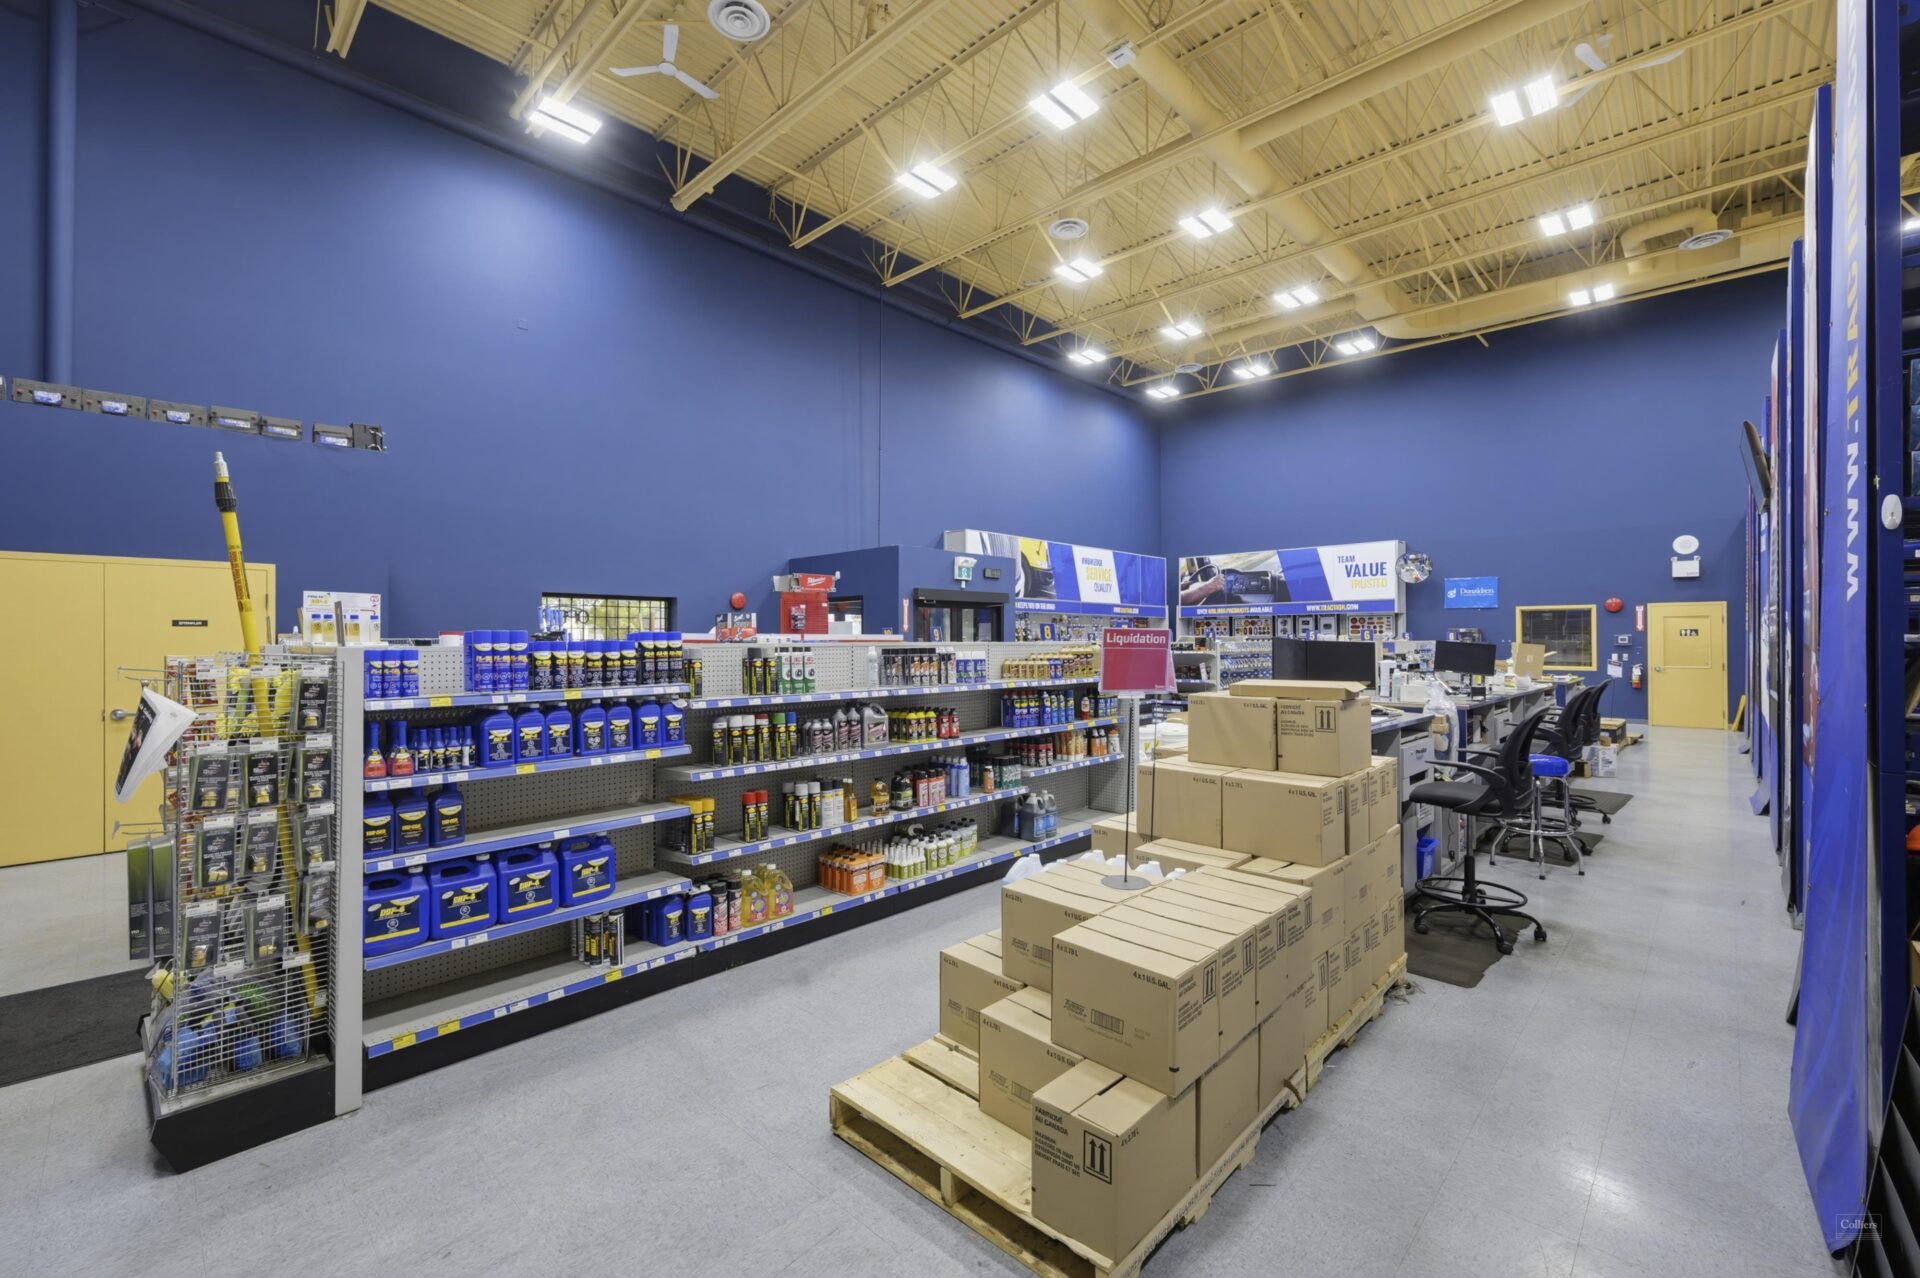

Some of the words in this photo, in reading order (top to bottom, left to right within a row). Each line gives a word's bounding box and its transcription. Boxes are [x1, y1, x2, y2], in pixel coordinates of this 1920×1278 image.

[1337, 555, 1355, 563] TEAM
[1345, 562, 1387, 578] VALUE
[1094, 582, 1112, 592] QUALITY
[934, 628, 940, 641] 9
[1044, 624, 1051, 640] 8
[1309, 631, 1315, 641] 5
[1364, 630, 1370, 640] 6
[1106, 632, 1166, 646] Liquidation
[1044, 1118, 1068, 1136] CANADA
